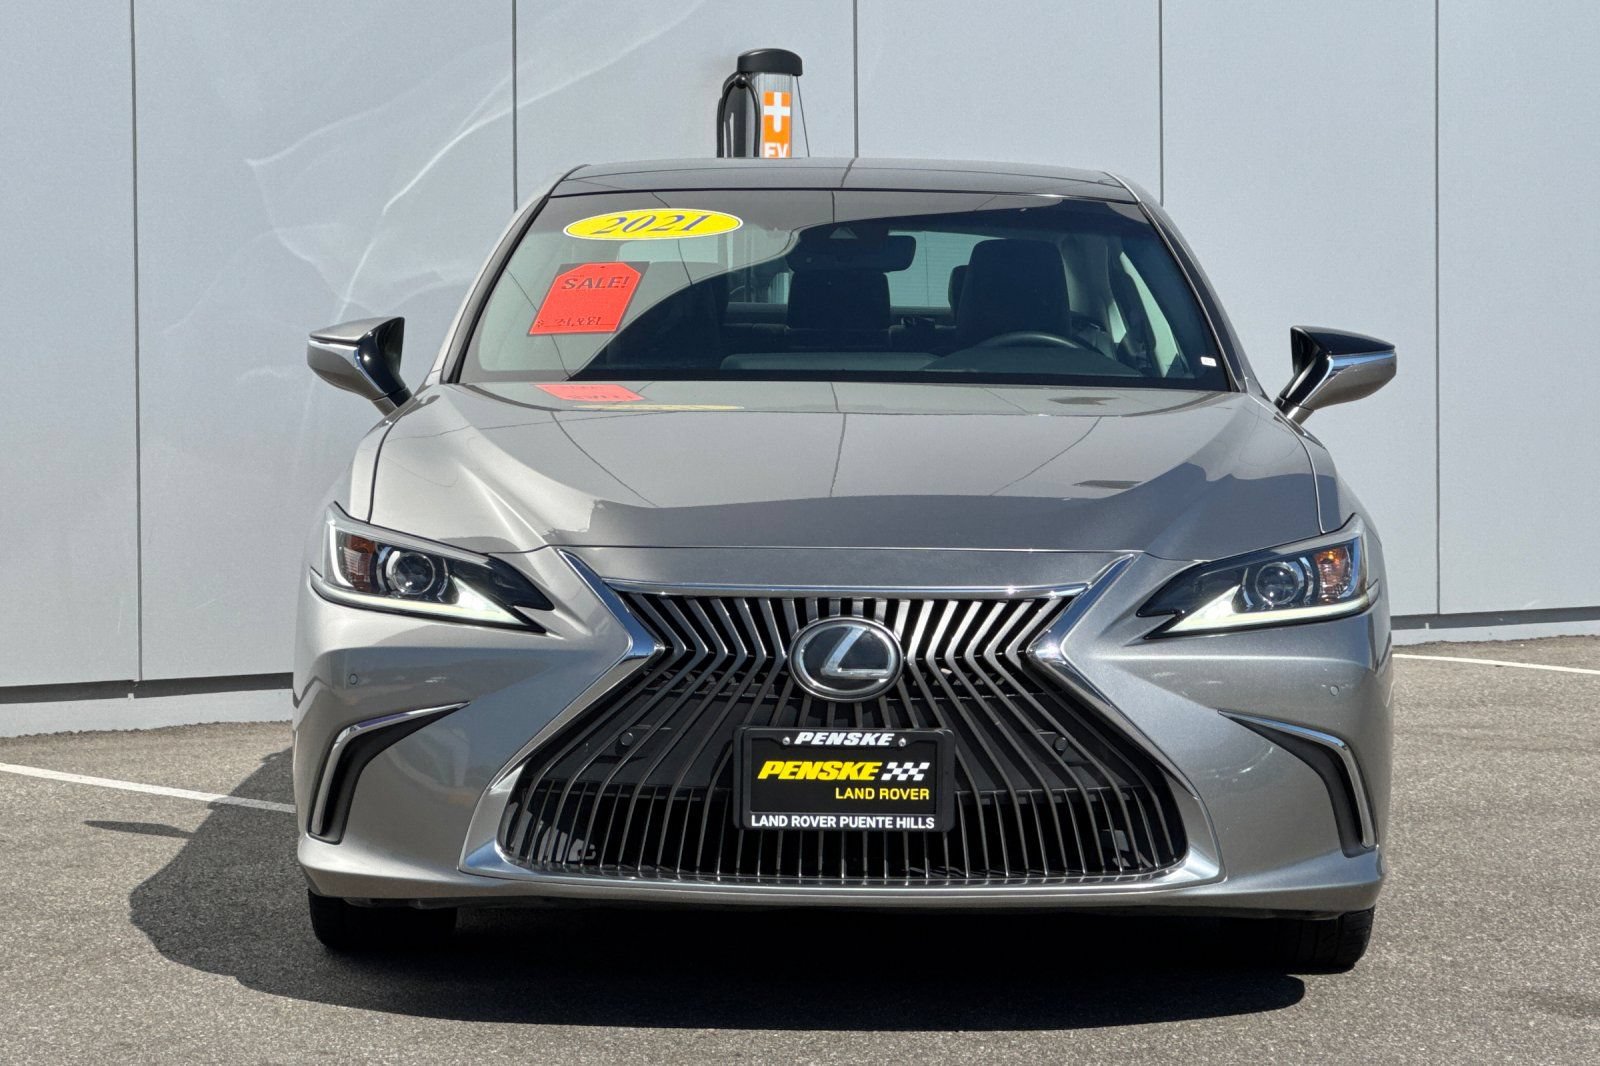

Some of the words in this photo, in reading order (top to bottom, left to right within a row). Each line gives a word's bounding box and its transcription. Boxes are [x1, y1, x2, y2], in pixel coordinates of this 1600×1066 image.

[764, 143, 789, 159] EV
[593, 214, 711, 235] 2021
[561, 276, 630, 290] SALE!
[794, 731, 896, 746] PENSKE
[757, 760, 883, 781] PENSKE
[835, 787, 875, 800] LAND
[879, 788, 930, 801] ROVER
[751, 814, 788, 827] LAND
[791, 815, 836, 828] ROVER
[840, 816, 893, 829] PUENTE
[896, 817, 935, 830] HILLS
